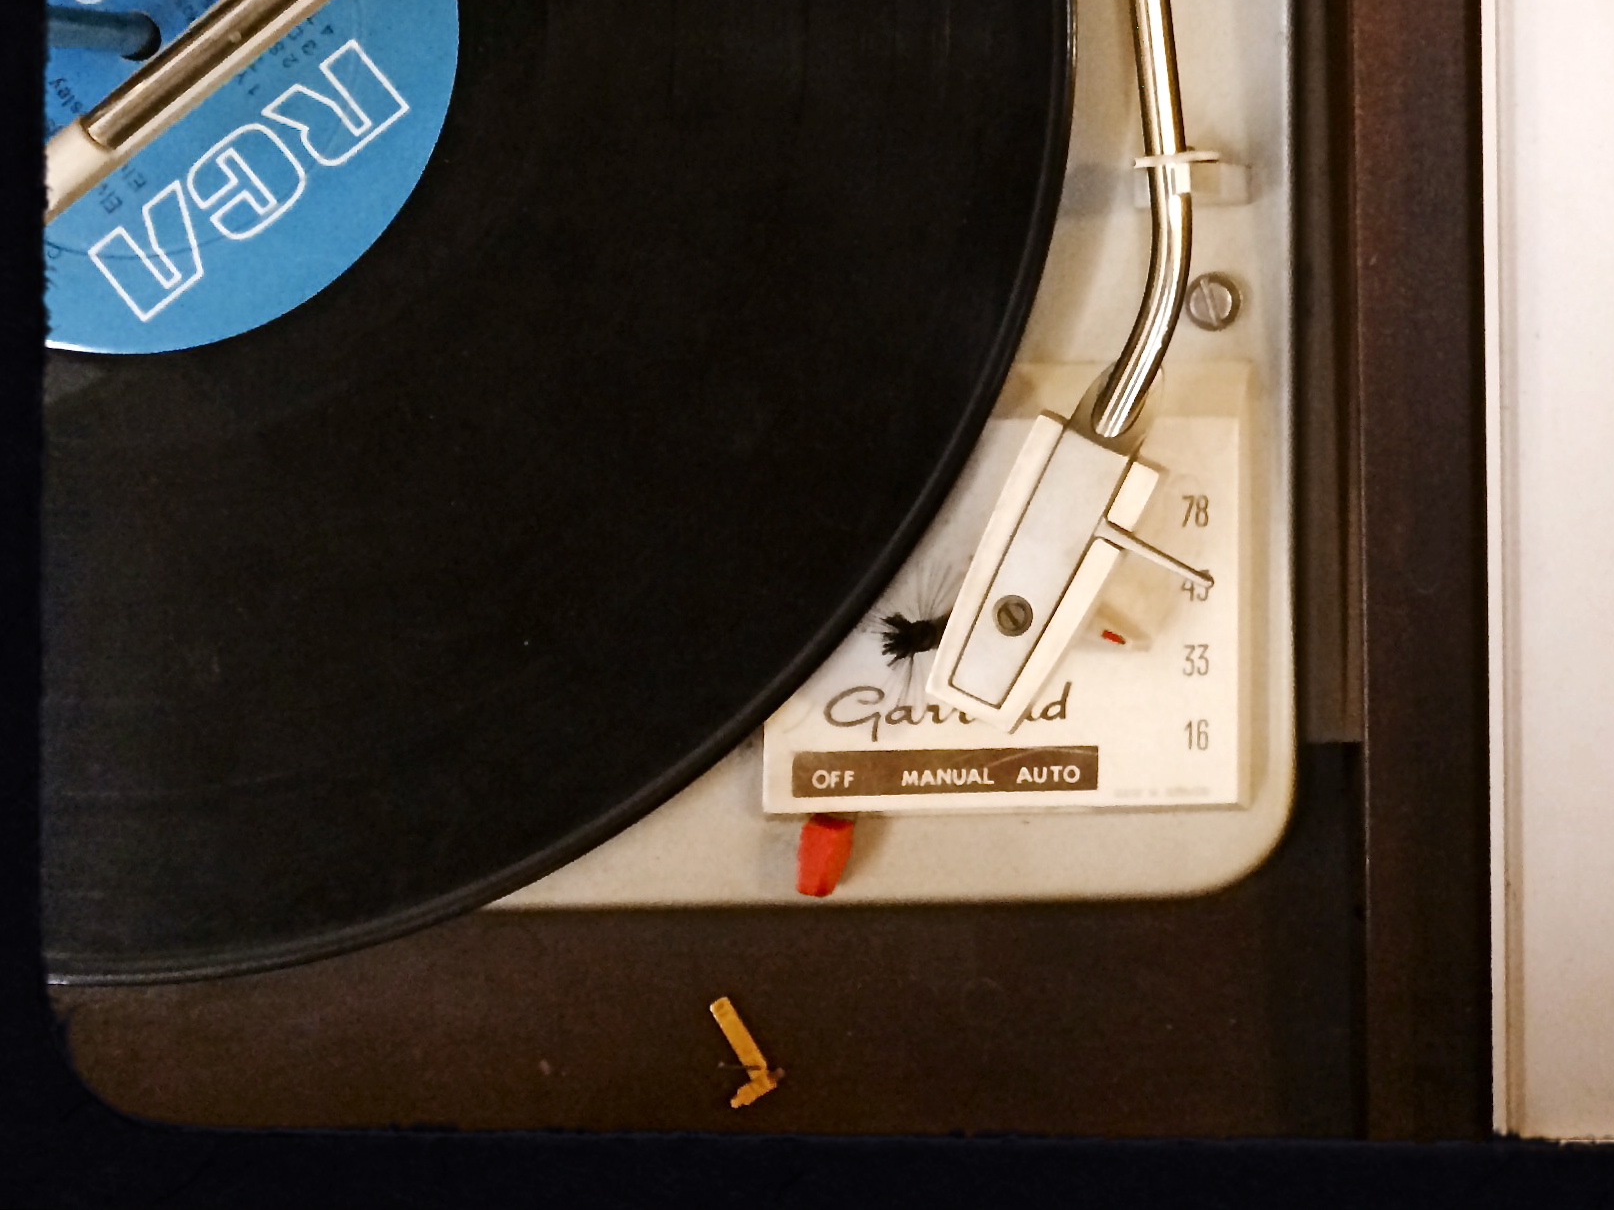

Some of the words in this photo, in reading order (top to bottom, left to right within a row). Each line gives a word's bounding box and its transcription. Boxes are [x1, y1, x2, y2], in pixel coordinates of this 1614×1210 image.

[87, 40, 409, 322] RCA
[1182, 496, 1209, 528] 78
[1182, 644, 1209, 676] 33
[1184, 719, 1209, 751] 16
[812, 770, 855, 789] OFF
[901, 768, 994, 787] MANUAL
[1016, 765, 1080, 784] AUTO
